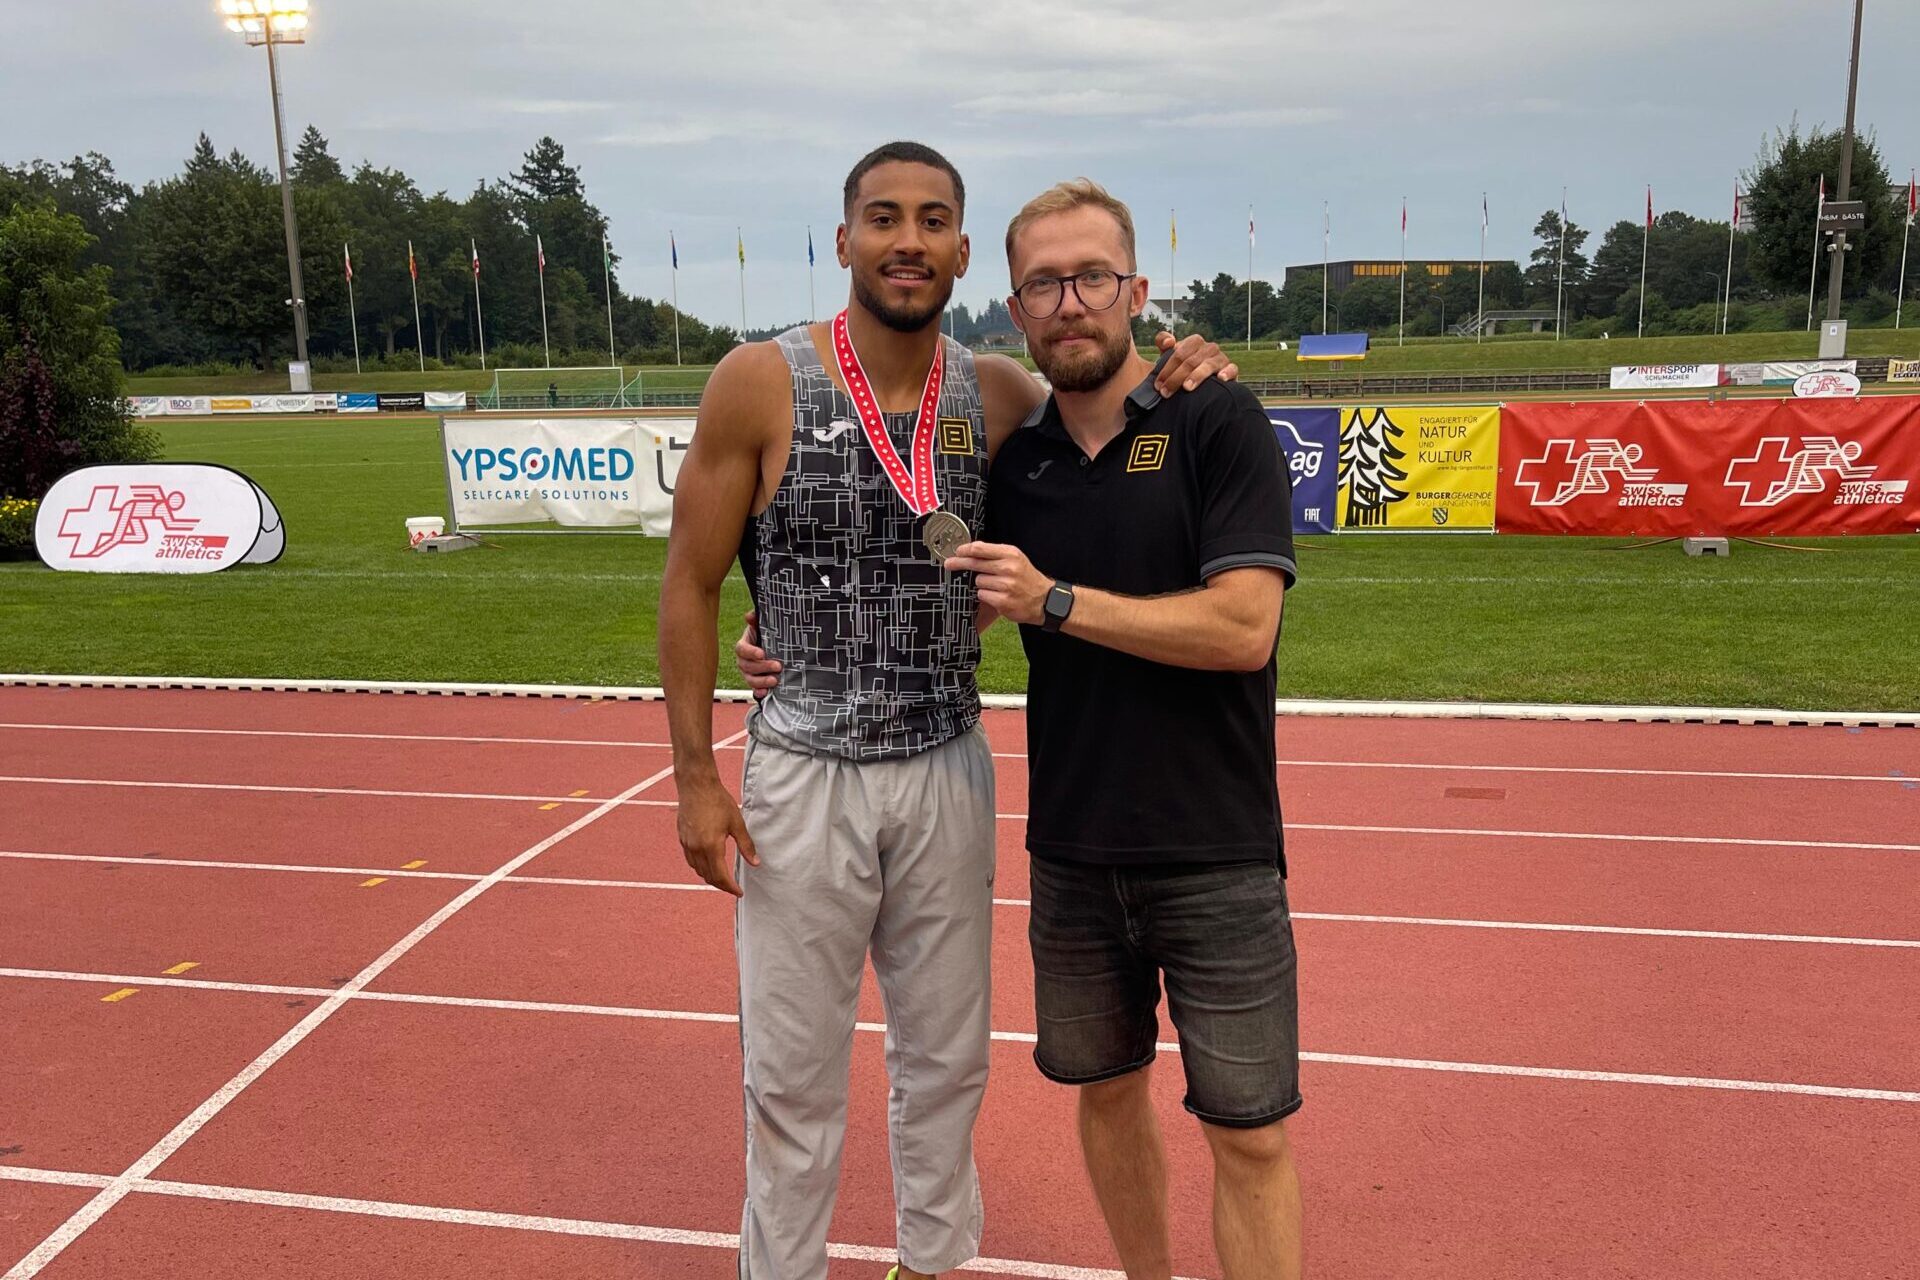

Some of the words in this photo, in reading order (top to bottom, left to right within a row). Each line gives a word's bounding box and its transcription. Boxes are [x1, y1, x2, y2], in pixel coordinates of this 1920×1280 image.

[1637, 365, 1700, 375] INTERSPORT
[1420, 417, 1462, 425] ENGAGIERT
[1463, 415, 1478, 424] FÜR
[1420, 425, 1467, 439] NATUR
[1418, 450, 1473, 463] KULTUR
[452, 447, 634, 481] YPSOMED
[1622, 486, 1665, 496] swiss
[1838, 483, 1883, 494] swiss
[464, 490, 530, 500] SELFCARE
[541, 489, 629, 501] SOLUTIONS
[1416, 491, 1493, 499] BURGERGEMEINDE
[1618, 494, 1684, 506] athletics
[1833, 491, 1904, 505] athletics
[1304, 508, 1321, 522] FIAT
[161, 536, 205, 548] swiss
[155, 546, 223, 560] athletics
